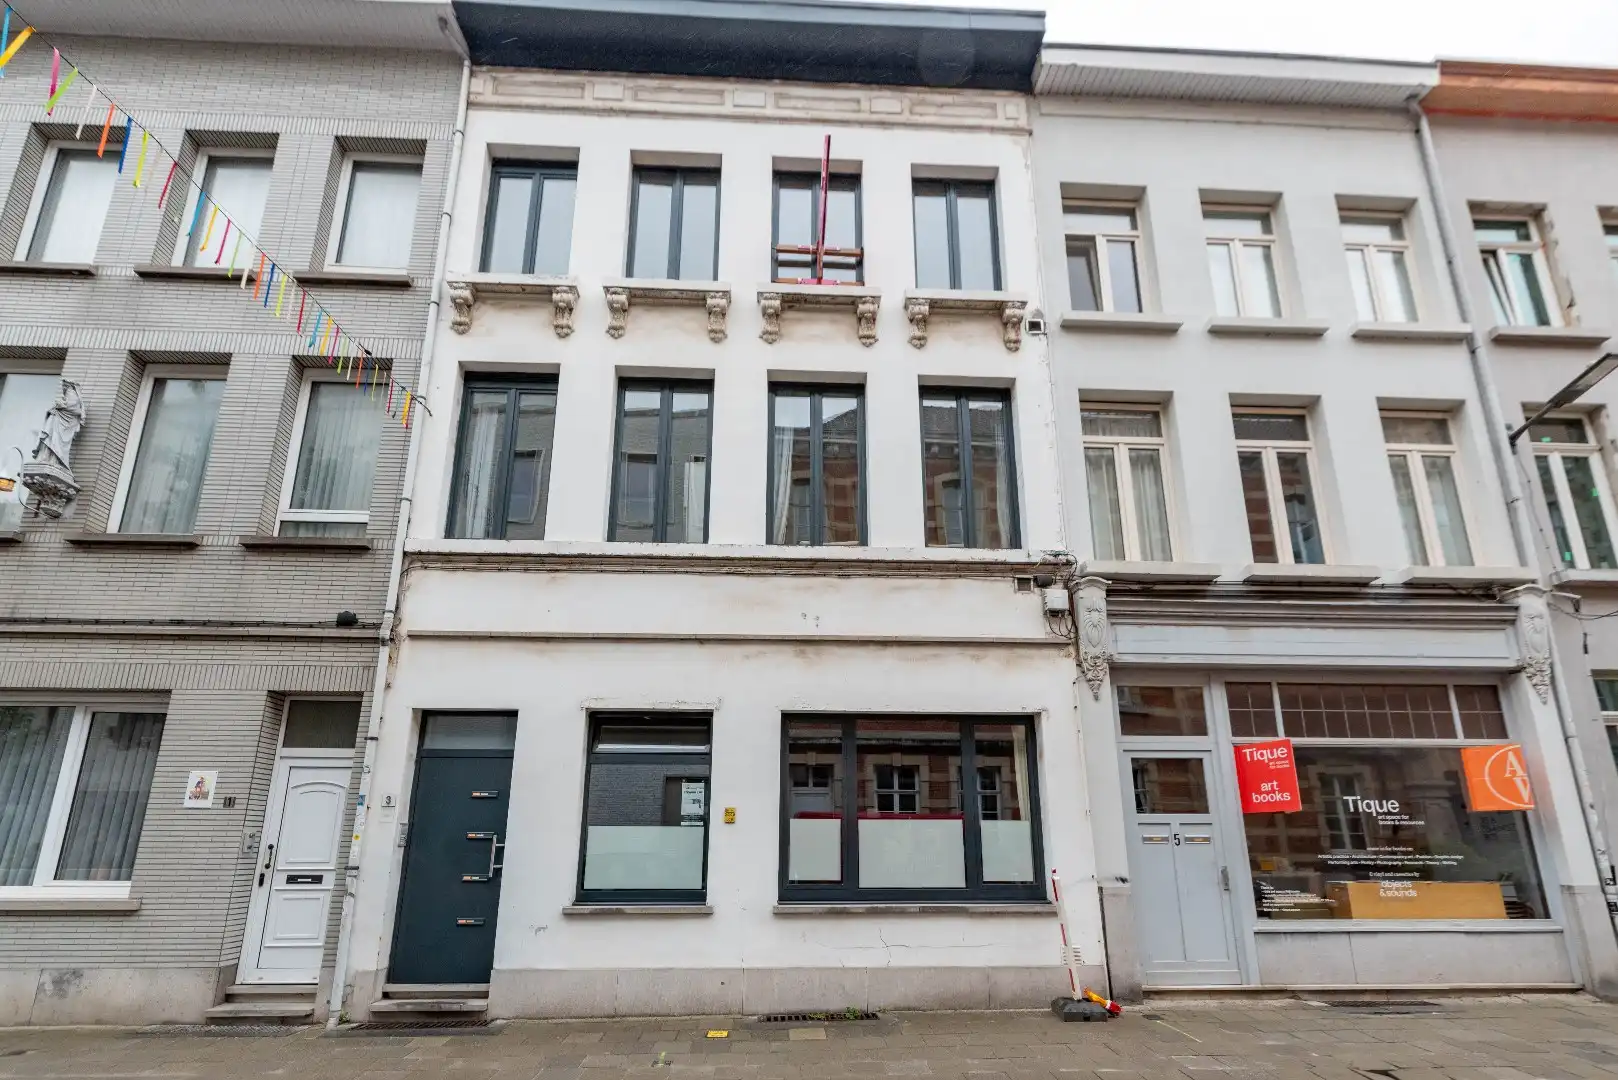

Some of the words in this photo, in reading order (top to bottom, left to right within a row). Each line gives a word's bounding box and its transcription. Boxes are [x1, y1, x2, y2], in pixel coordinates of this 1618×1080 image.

[1242, 746, 1288, 763] Tique
[1504, 751, 1528, 777] A
[1261, 780, 1280, 791] art
[385, 795, 392, 805] 3
[1252, 791, 1291, 803] books
[1343, 795, 1400, 816] Tique
[1174, 833, 1181, 846] 5
[1381, 880, 1413, 890] objects
